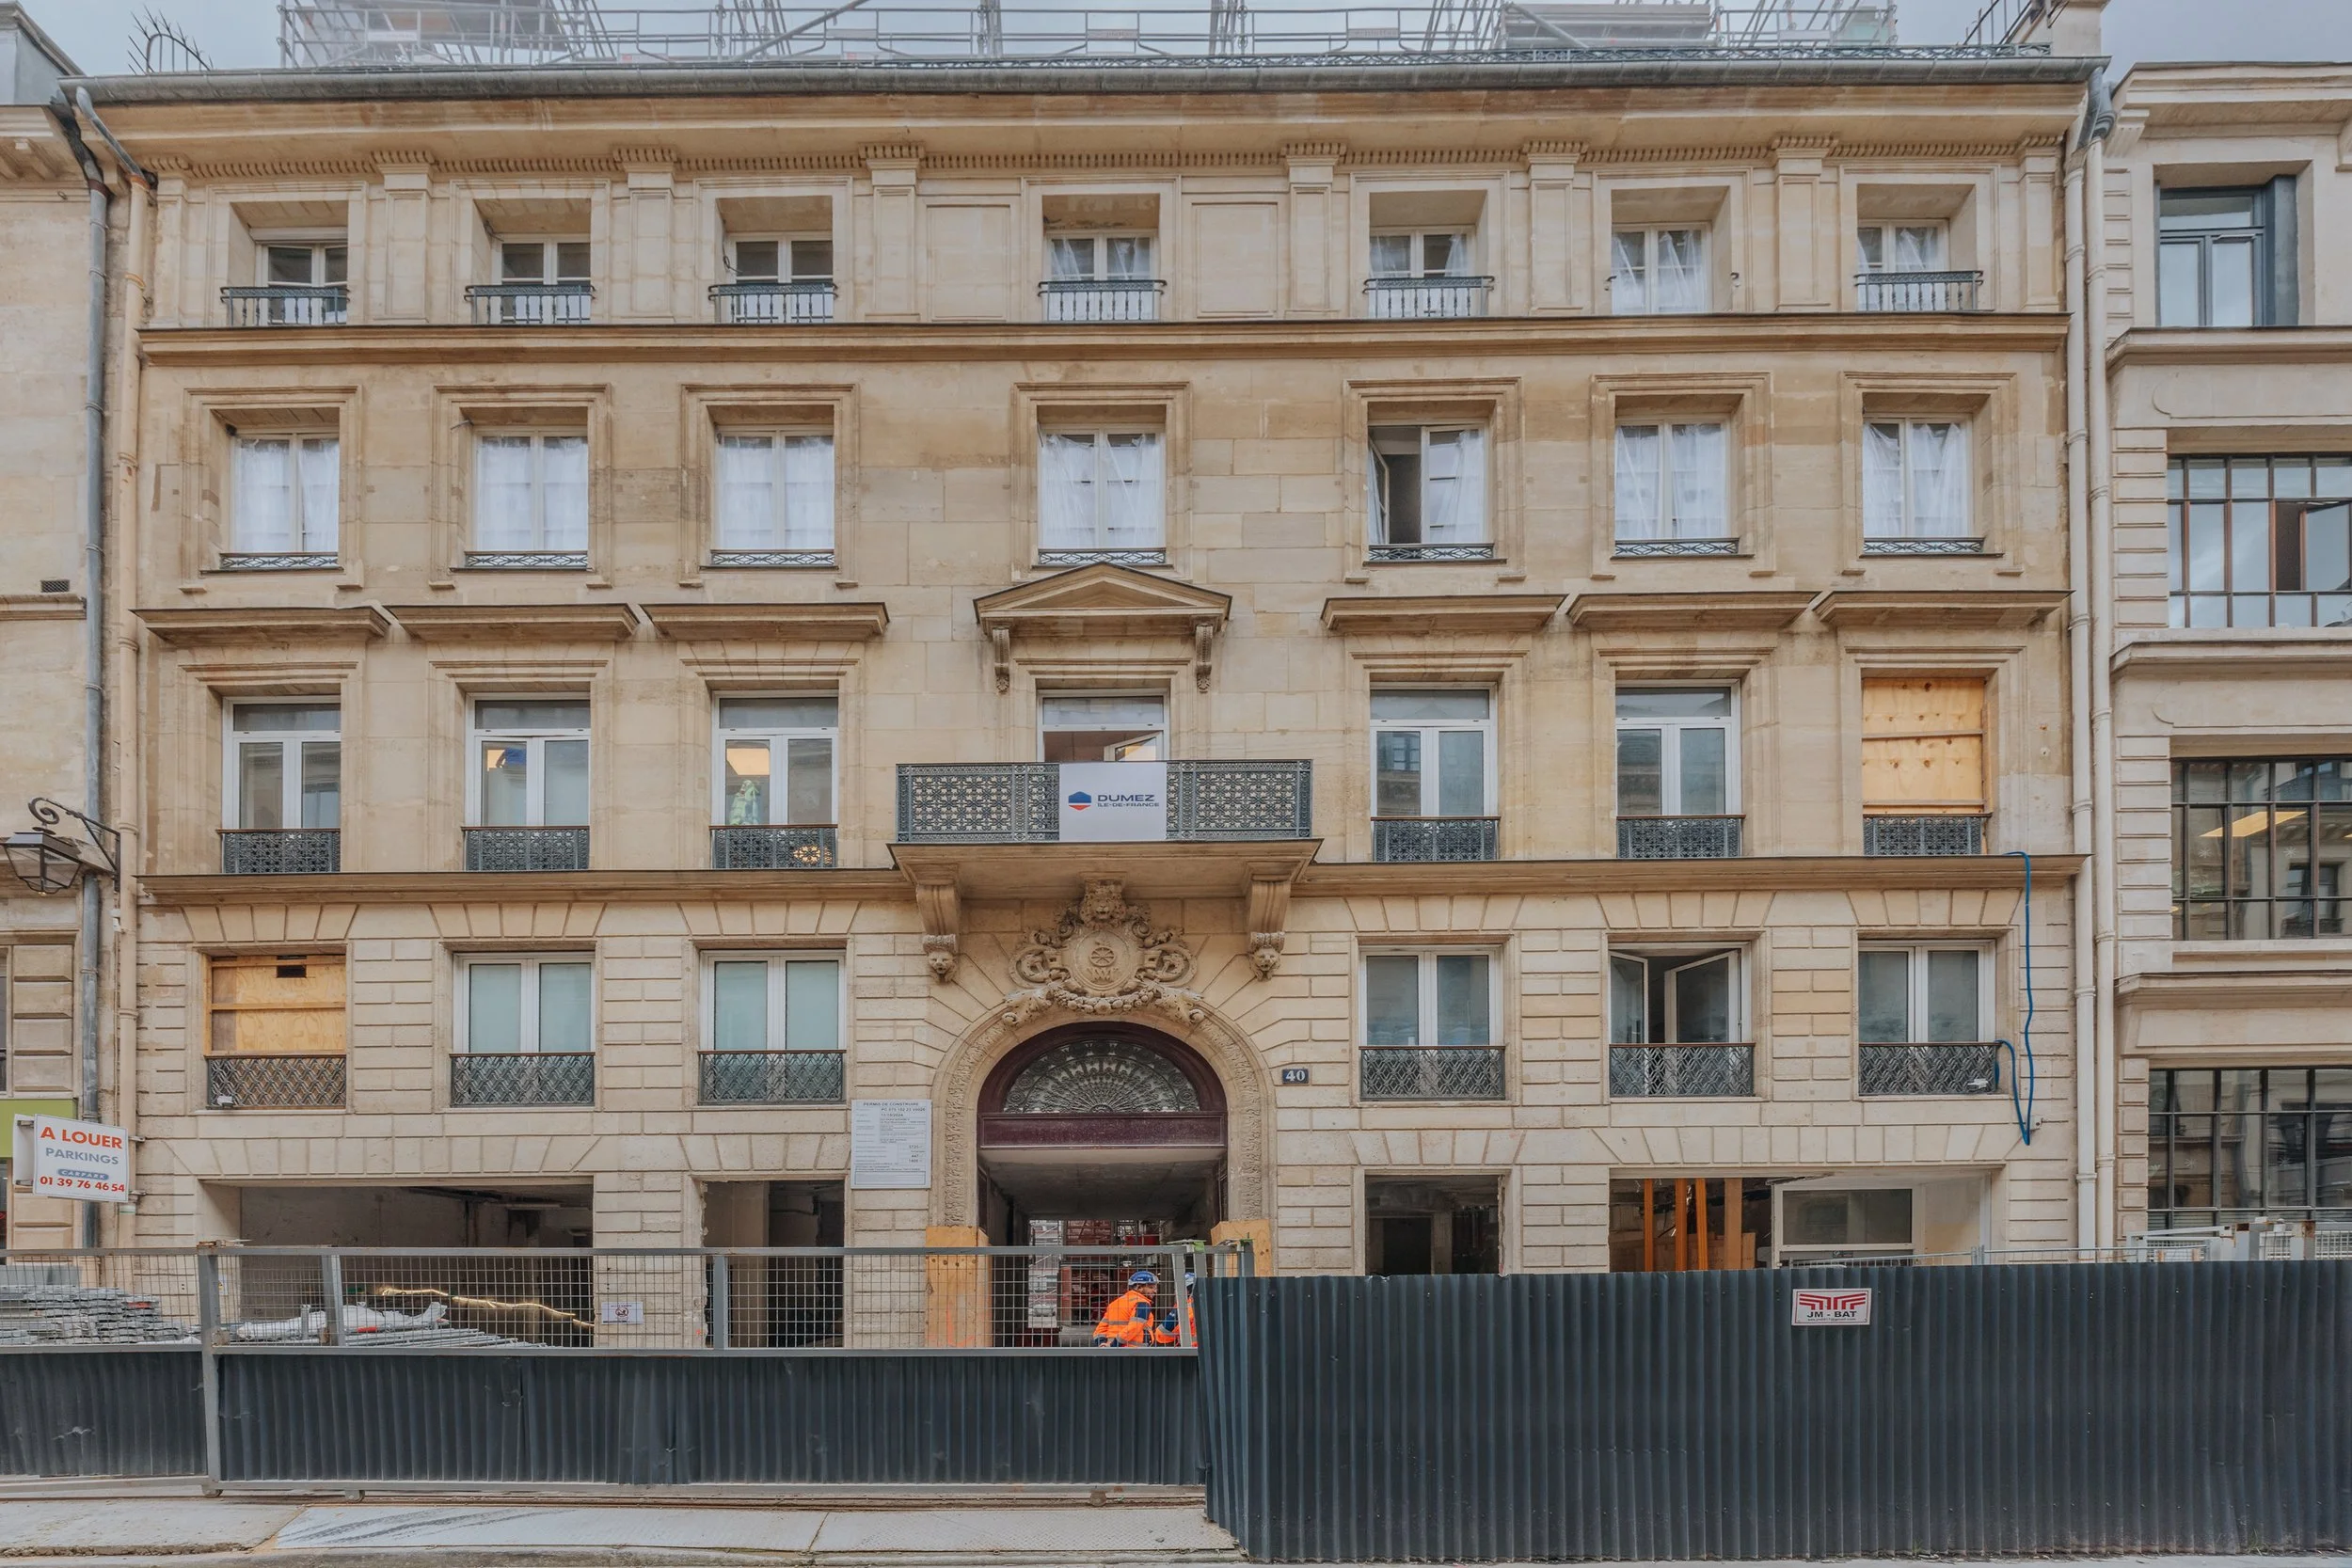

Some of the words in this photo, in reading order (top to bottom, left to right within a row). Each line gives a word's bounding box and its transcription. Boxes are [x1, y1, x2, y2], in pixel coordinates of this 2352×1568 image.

[1098, 794, 1155, 802] DUMEZ
[1285, 1069, 1306, 1082] 40
[40, 1126, 56, 1140] A
[61, 1129, 122, 1148] LOUER
[45, 1148, 119, 1164] PARKINGS
[61, 1169, 106, 1180] CARPARK
[40, 1176, 54, 1185] 01
[56, 1178, 72, 1187] 39
[77, 1180, 91, 1189] 76
[95, 1181, 109, 1191] 46
[111, 1183, 125, 1193] 54
